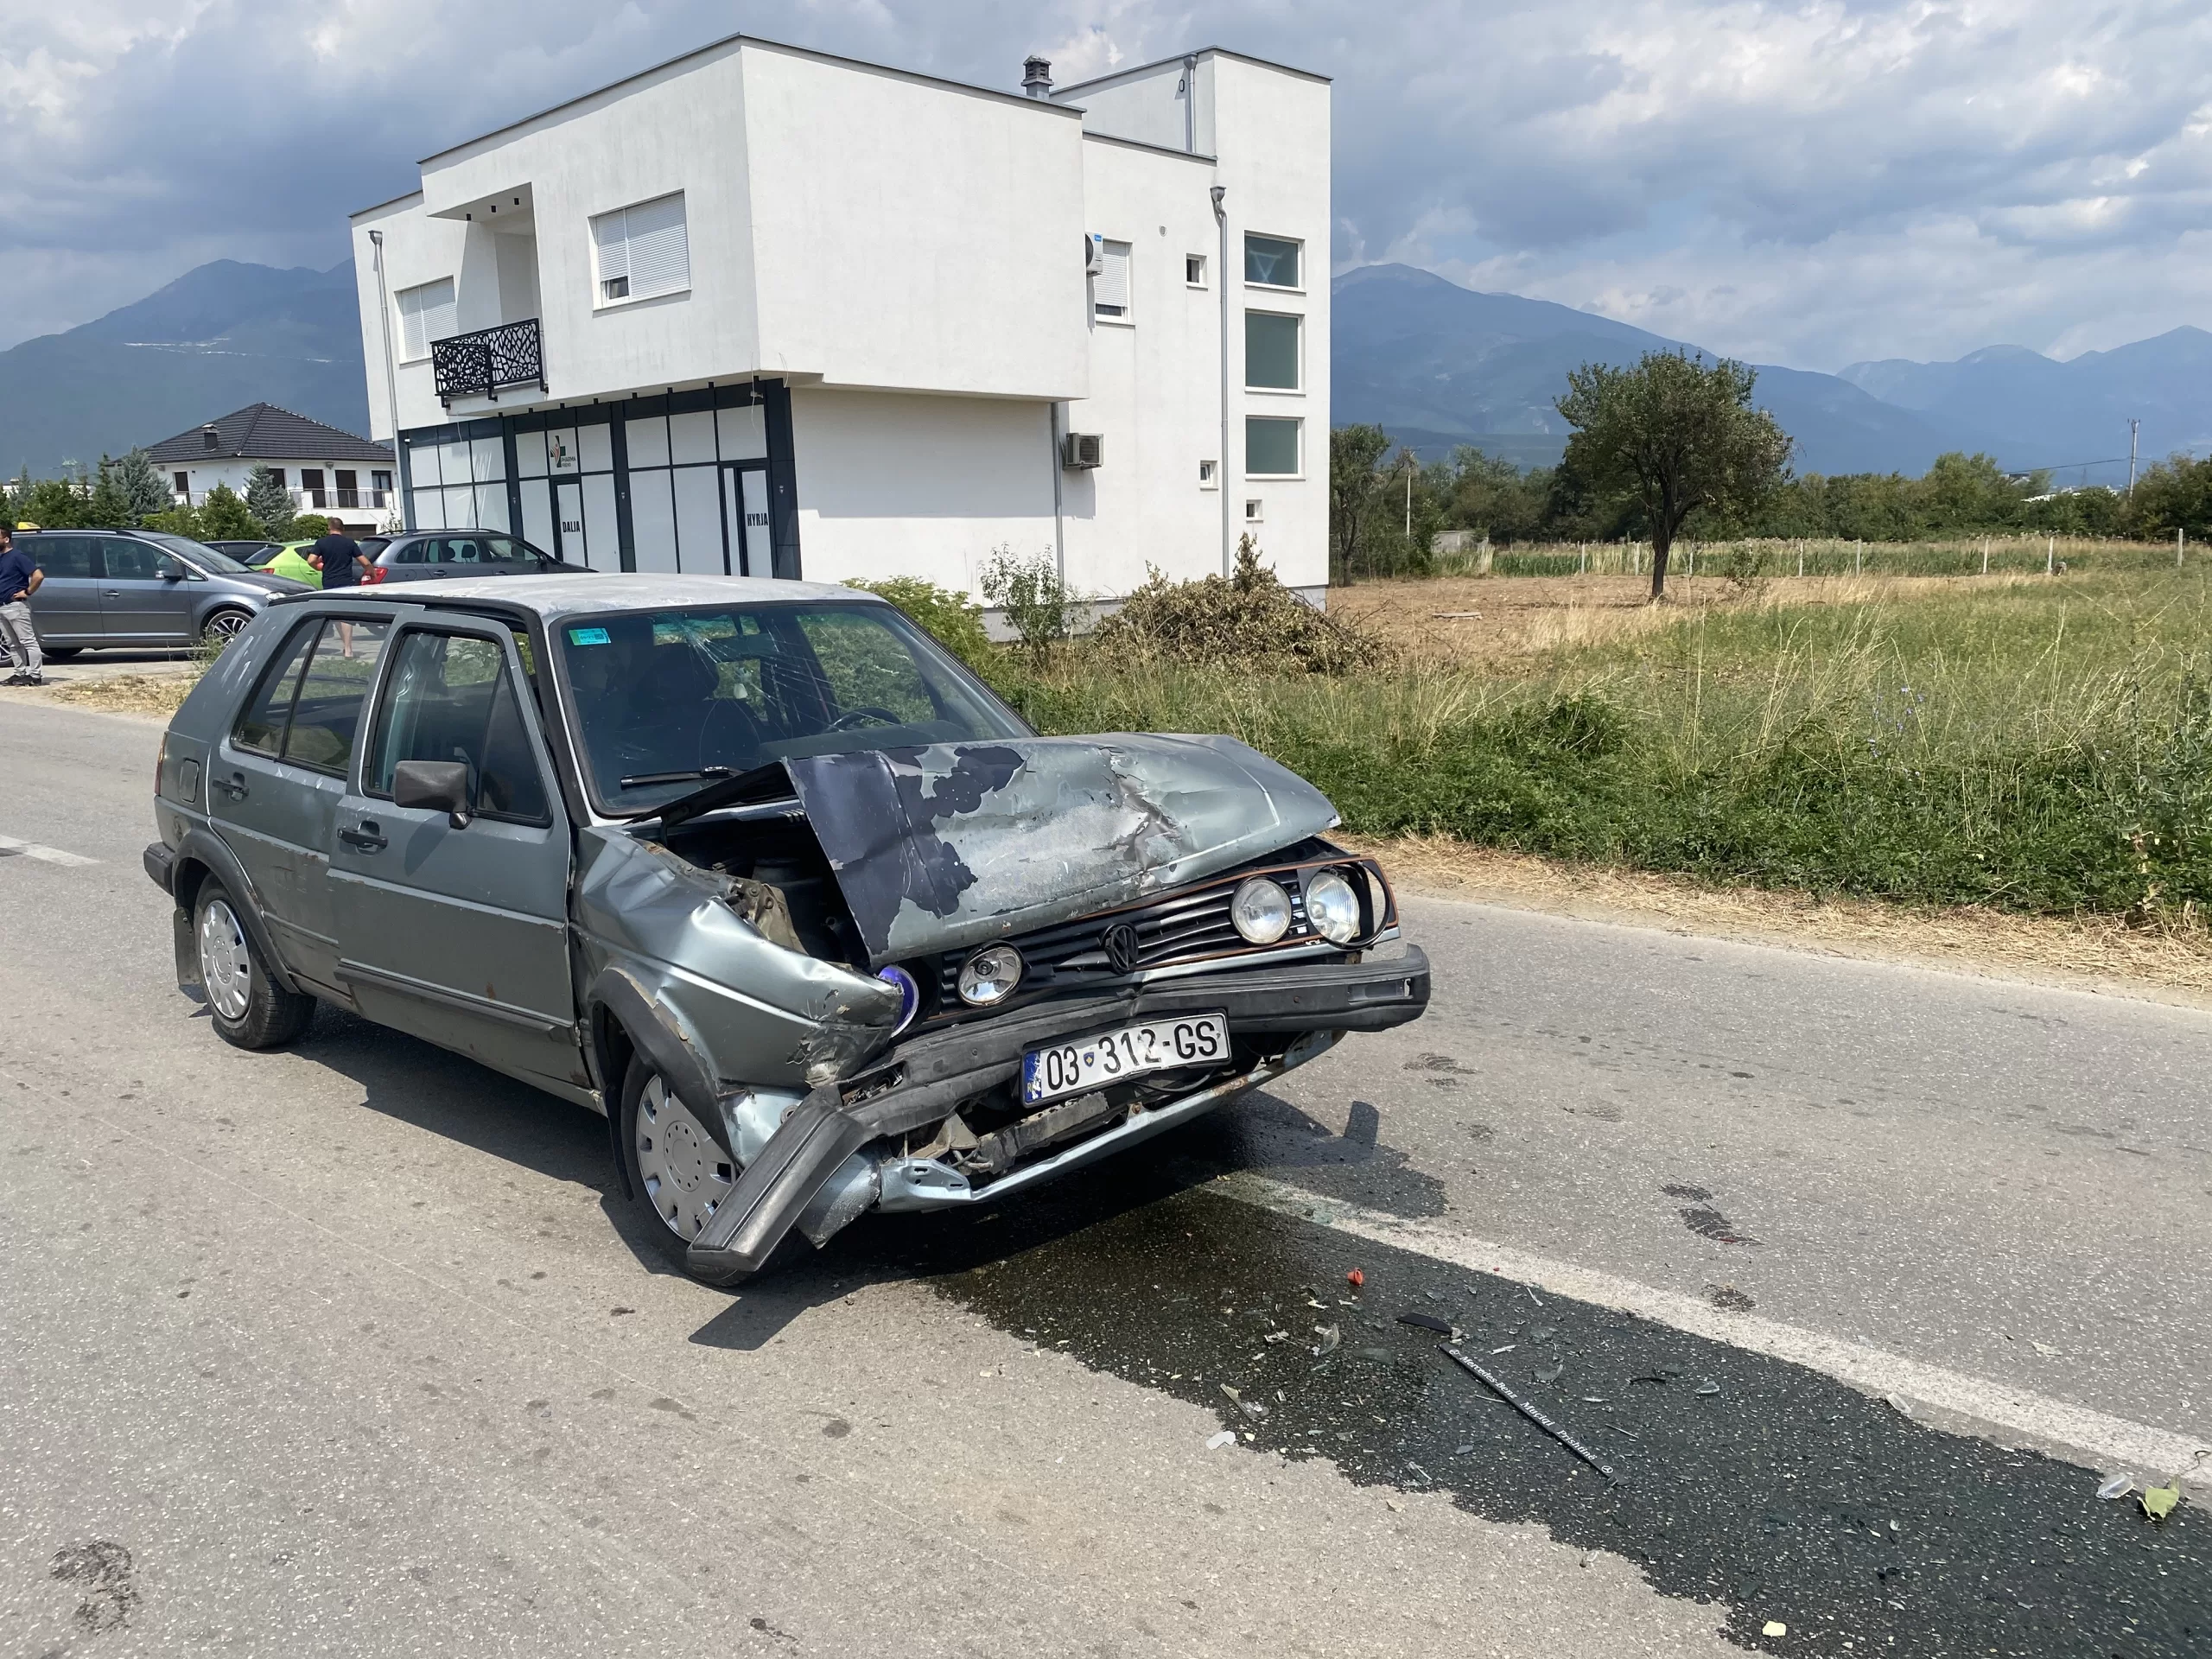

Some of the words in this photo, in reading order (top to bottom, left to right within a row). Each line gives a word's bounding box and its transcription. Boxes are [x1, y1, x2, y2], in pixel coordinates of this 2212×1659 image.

[562, 520, 580, 532] DALJA
[747, 512, 768, 526] HYRJA
[1046, 1046, 1080, 1090] 03
[1098, 1020, 1218, 1074] 312-GS
[1459, 1356, 1518, 1399] Mercedes-Benz
